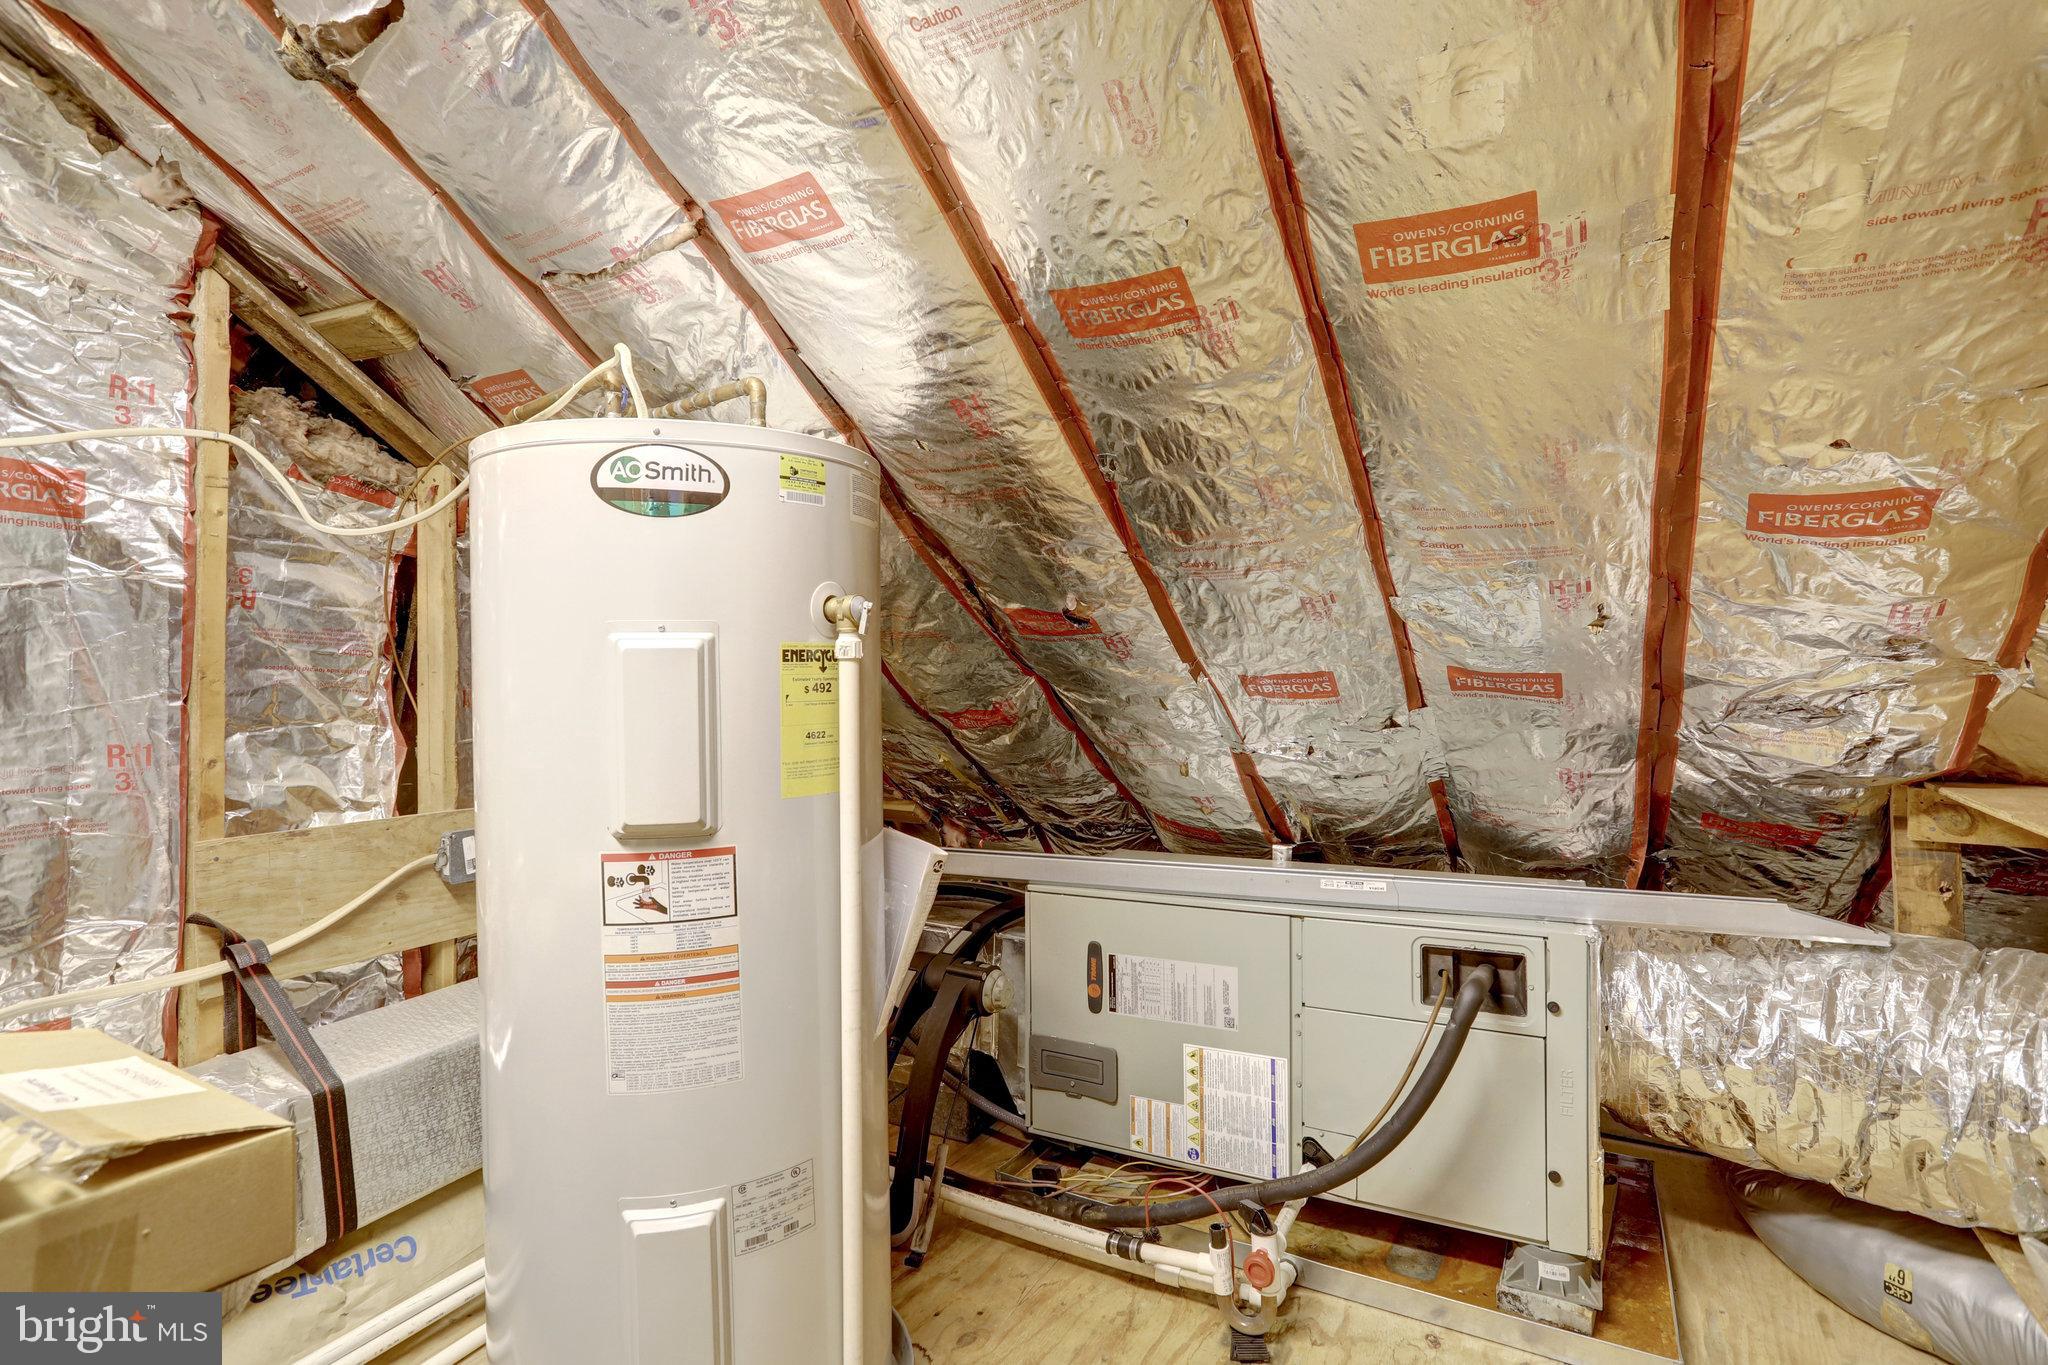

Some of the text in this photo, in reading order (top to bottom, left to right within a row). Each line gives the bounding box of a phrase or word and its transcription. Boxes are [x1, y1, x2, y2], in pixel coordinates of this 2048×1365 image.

[909, 5, 962, 32] Caution
[736, 186, 815, 217] OWENS/CORNING
[1866, 214, 1898, 227] side
[1902, 204, 1957, 221] toward
[1961, 194, 2004, 212] living
[730, 200, 828, 240] FIBERGLAS
[1391, 209, 1526, 243] OWENS/CORNING
[778, 242, 812, 261] leading
[811, 232, 856, 252] insulation
[1369, 224, 1527, 270] FIBERGLAS
[1781, 258, 1997, 296] Special care should be taken when working
[1784, 269, 1827, 280] Fiberglas
[1829, 262, 1876, 276] insulation
[1877, 262, 1887, 270] is
[1827, 275, 1837, 284] is
[1839, 268, 1898, 283] combustible
[1923, 257, 1960, 272] should
[1962, 253, 1981, 264] not
[1367, 284, 1417, 300] World's
[1418, 276, 1470, 294] leading
[1472, 263, 1543, 285] insulation
[1080, 279, 1179, 308] OWENS/CORNING
[1809, 289, 1832, 299] with
[1832, 290, 1845, 298] an
[1845, 286, 1871, 298] open
[1067, 292, 1186, 327] FIBERGLAS
[1152, 324, 1206, 342] insulation
[645, 460, 712, 484] Smith
[1786, 494, 1925, 512] OWENS/CORNING
[26, 517, 86, 532] insulation
[1416, 525, 1439, 533] Apply
[1504, 521, 1528, 530] living
[1529, 519, 1556, 528] space
[1757, 506, 1923, 529] FIBERGLAS
[1419, 540, 1464, 550] Caution
[1744, 533, 1927, 549] World's leading insulation
[782, 649, 839, 663] ENERGYGU
[812, 682, 832, 694] 492
[1247, 682, 1333, 693] FIBERGLAS
[1455, 678, 1556, 694] FIBERGLAS
[1473, 674, 1554, 684] OWENS/CORNING
[1452, 691, 1485, 699] World's
[805, 730, 826, 740] 4622
[107, 743, 153, 769] R-11
[38, 784, 63, 794] living
[659, 851, 693, 860] DANGER
[660, 978, 686, 986] DANGER
[1559, 1069, 1575, 1119] FILTER
